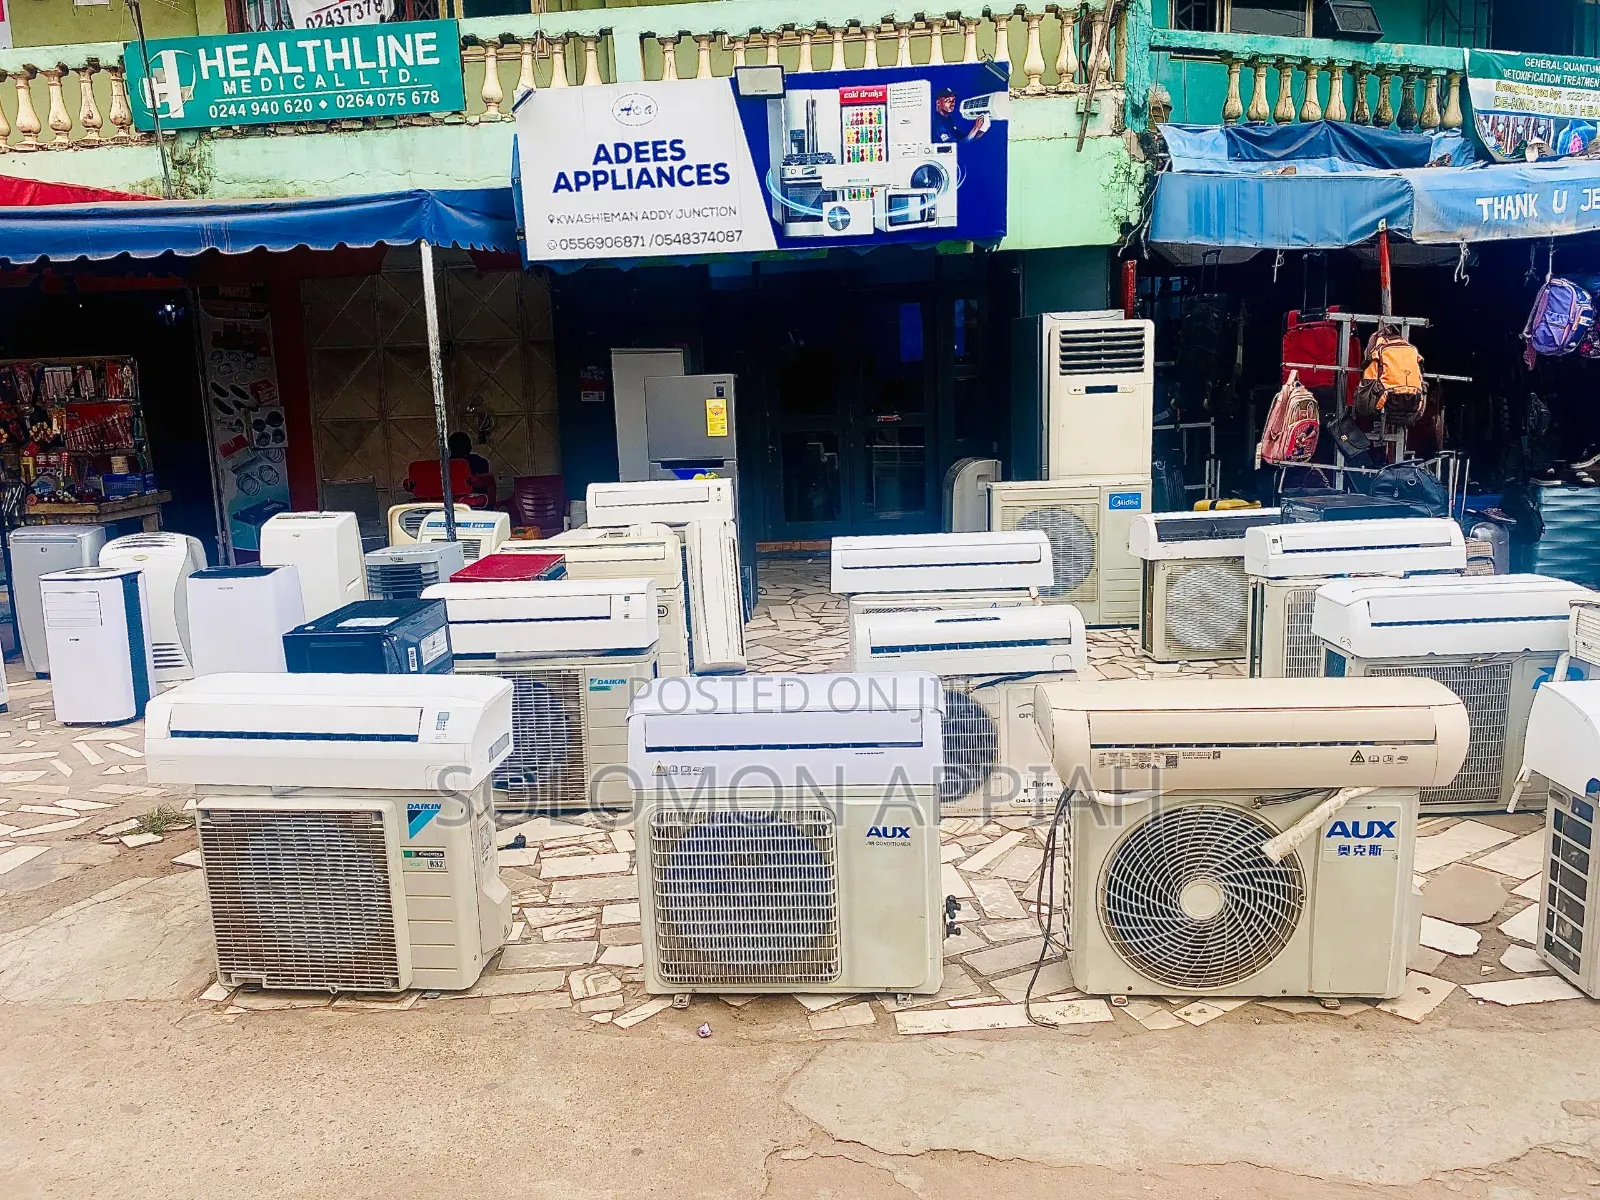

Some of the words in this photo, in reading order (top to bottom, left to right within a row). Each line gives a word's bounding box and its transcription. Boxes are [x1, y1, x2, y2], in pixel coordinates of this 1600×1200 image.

[198, 32, 440, 80] HEALTHLINE
[1524, 57, 1562, 70] GENERAL
[222, 72, 345, 95] MEDICAL
[359, 68, 418, 86] LTD.
[1502, 68, 1561, 84] DETOXIFICATION
[843, 90, 859, 99] cold
[208, 103, 247, 119] 0244
[251, 100, 279, 116] 940
[283, 98, 313, 114] 620
[336, 95, 374, 109] 0264
[377, 92, 406, 107] 075
[411, 90, 440, 105] 678
[592, 139, 686, 165] ADEES
[552, 162, 730, 193] APPLIANCES
[556, 212, 639, 225] KWASHIEMAN
[641, 209, 674, 222] ADDY
[675, 205, 737, 220] JUNCTION
[1475, 192, 1539, 225] THANK
[1552, 189, 1568, 214] U
[558, 235, 646, 250] 0556906871
[1112, 495, 1139, 507] Midea
[866, 826, 911, 839] AUX
[1325, 820, 1398, 839] AUX
[1338, 844, 1383, 857] 奥克斯
[429, 860, 444, 868] R32
